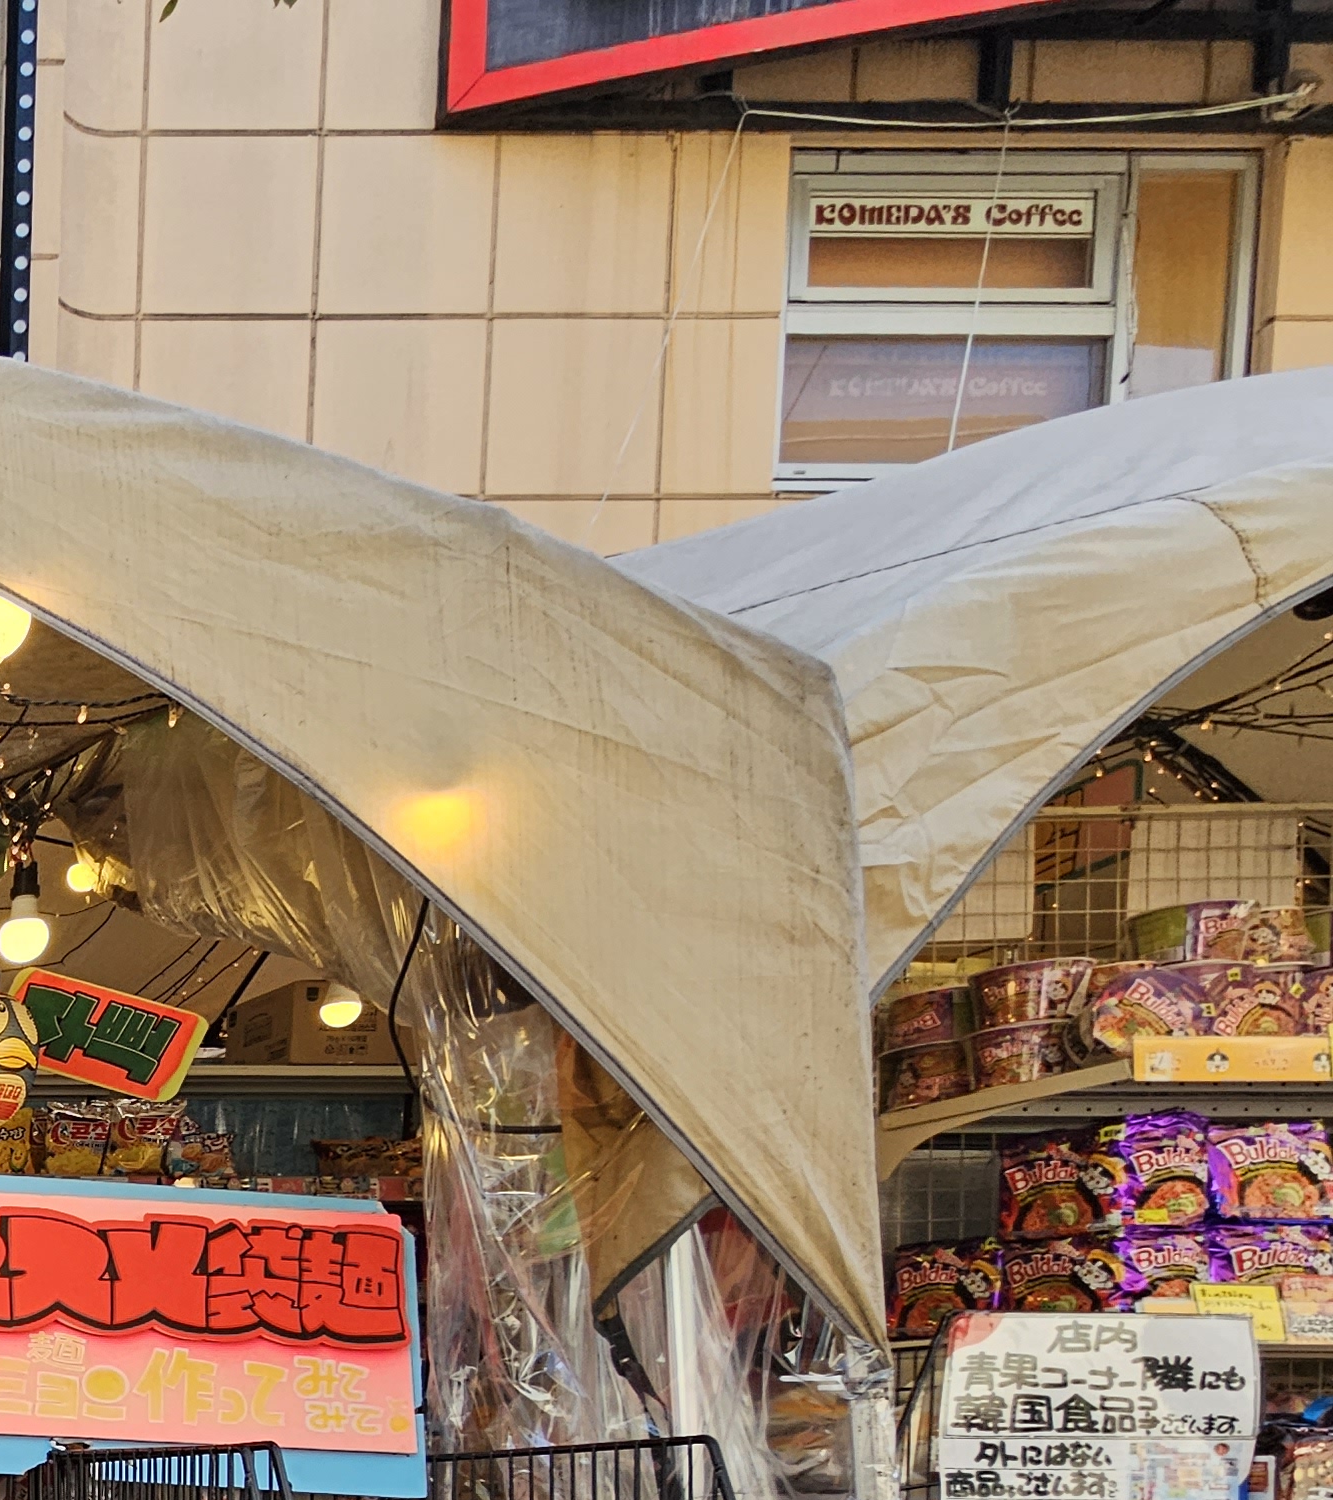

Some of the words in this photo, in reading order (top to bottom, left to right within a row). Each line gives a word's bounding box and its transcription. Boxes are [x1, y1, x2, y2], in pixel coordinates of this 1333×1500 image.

[984, 202, 1083, 229] Coffee
[1046, 1320, 1138, 1353] 店内
[975, 1441, 1112, 1468] 外にはない
